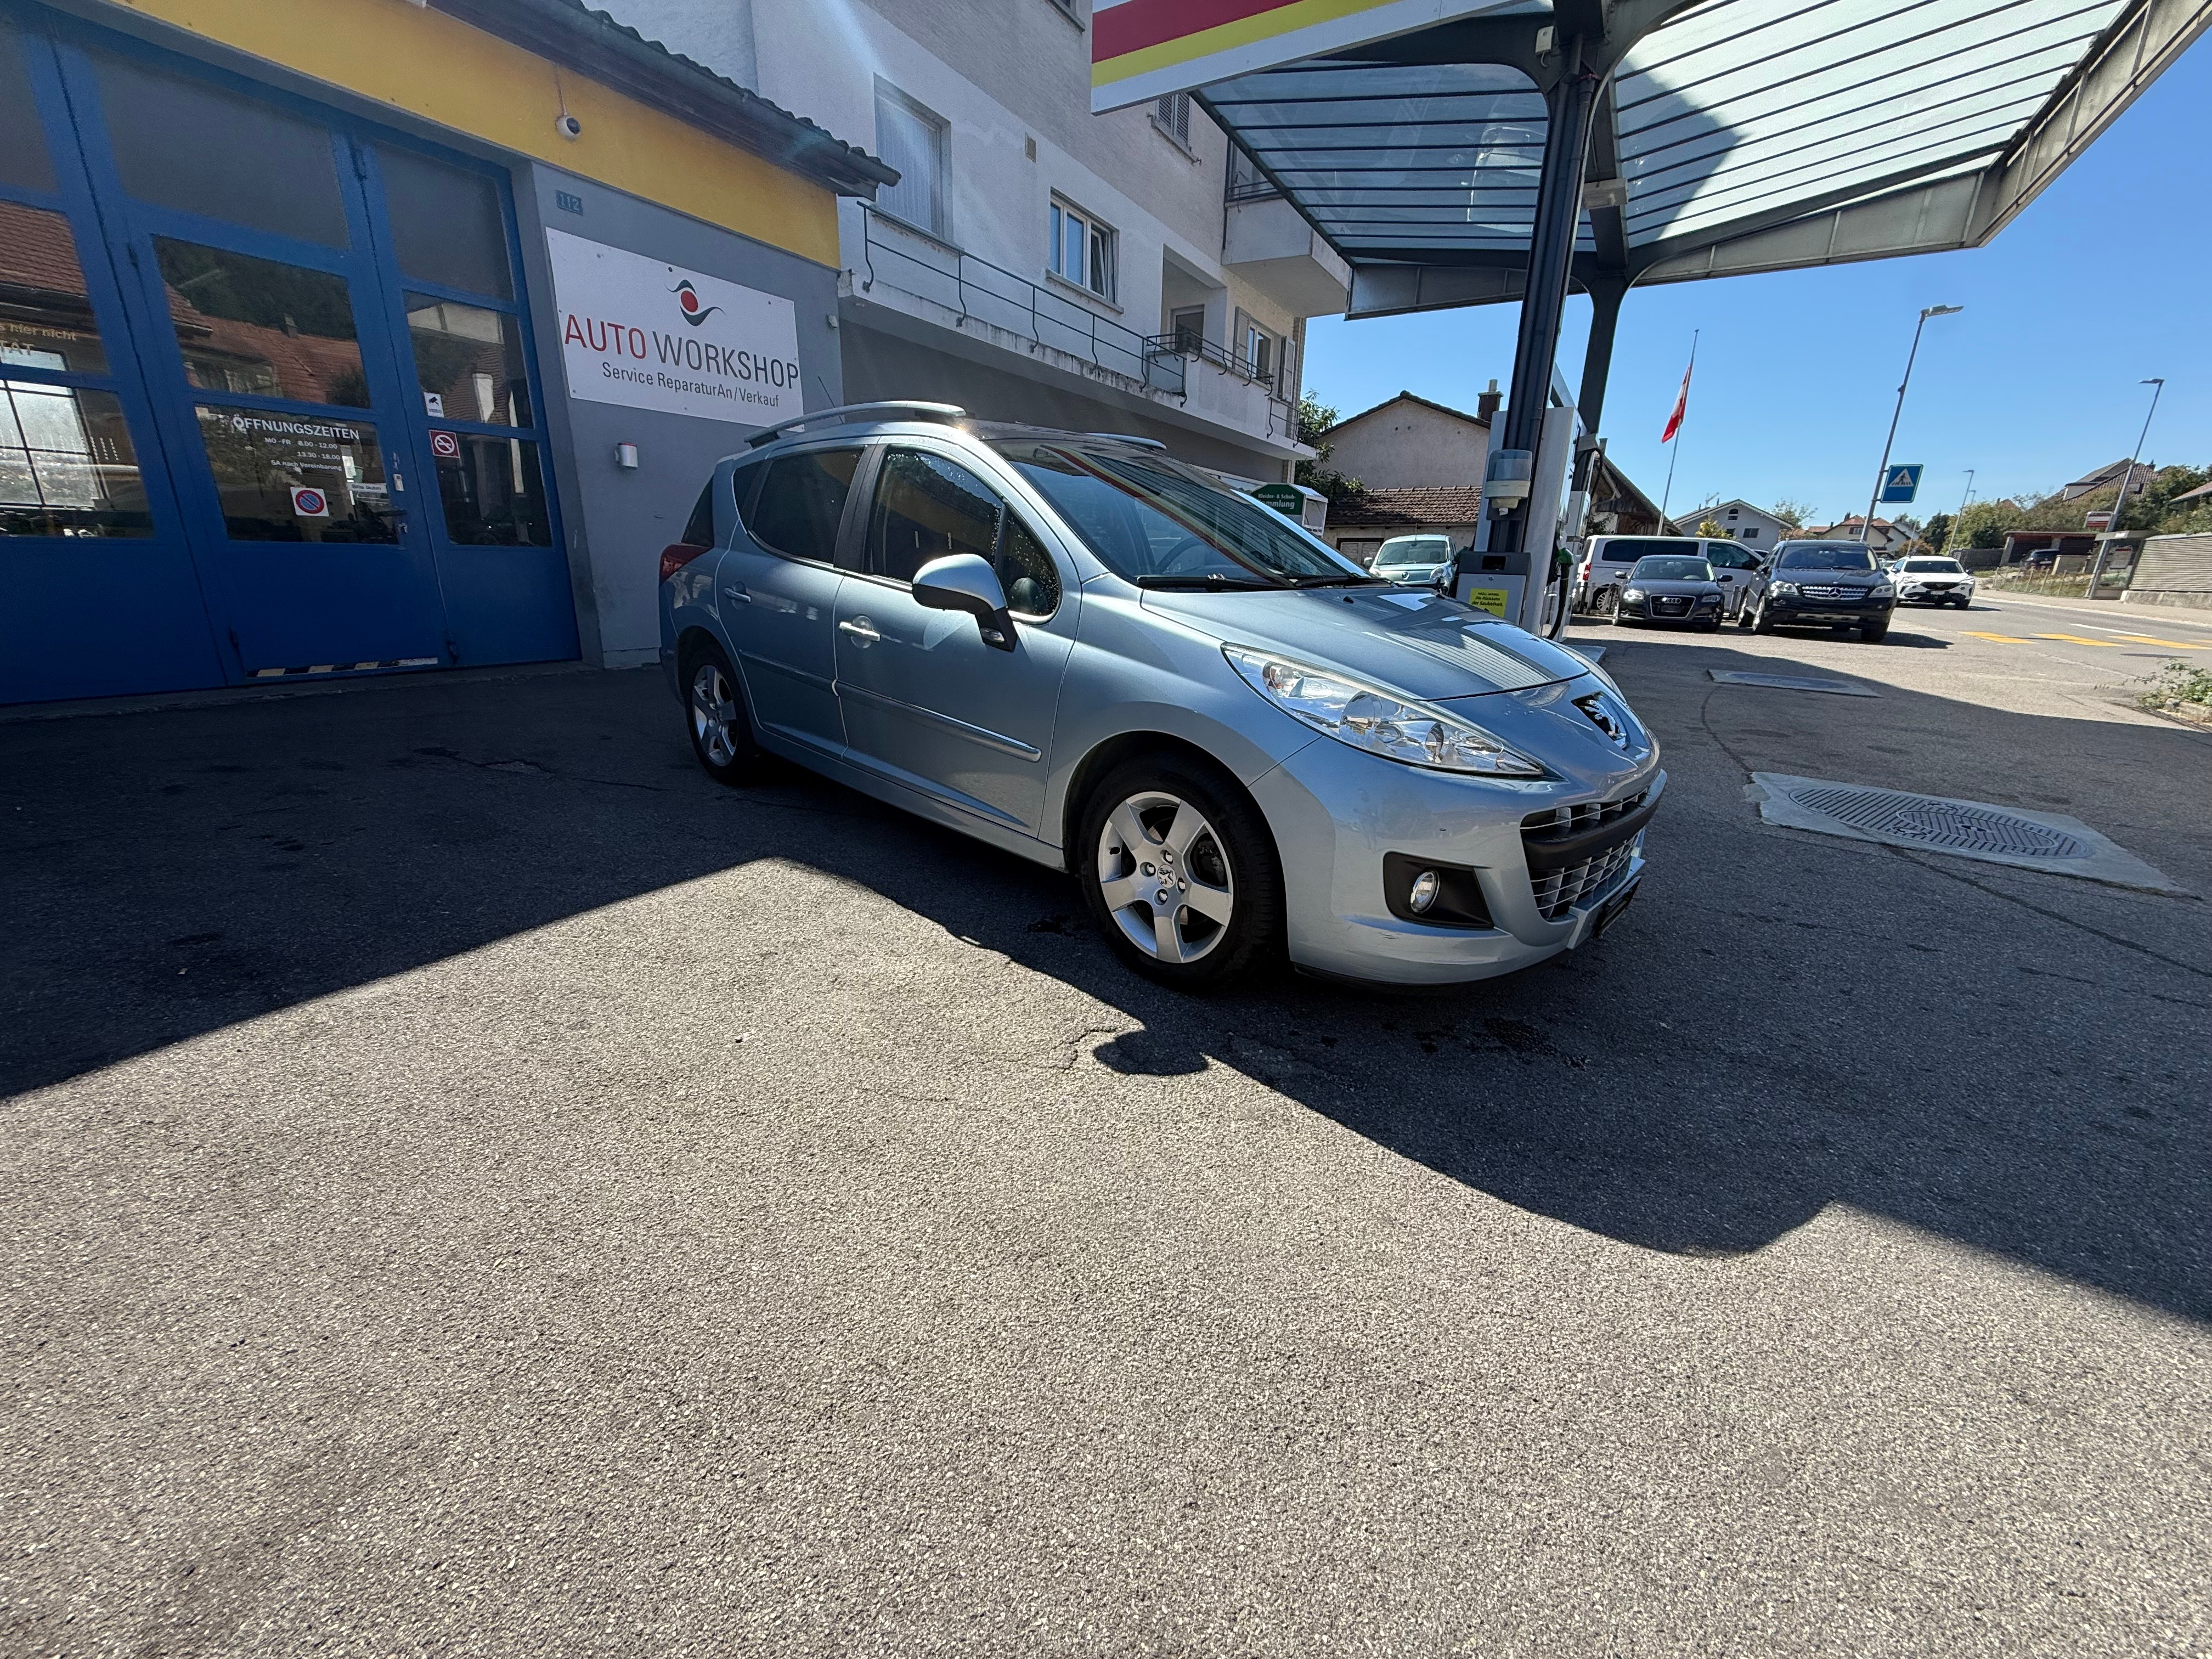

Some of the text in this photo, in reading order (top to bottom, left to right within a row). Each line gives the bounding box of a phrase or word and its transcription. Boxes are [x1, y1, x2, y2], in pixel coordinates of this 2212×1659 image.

[560, 193, 580, 211] 112
[42, 328, 77, 341] nicht
[564, 314, 799, 390] AUTO WORKSHOP
[602, 362, 653, 385] Service
[233, 414, 360, 440] ÖFFNUNGSZEITEN
[299, 462, 343, 471] Vereinbarung
